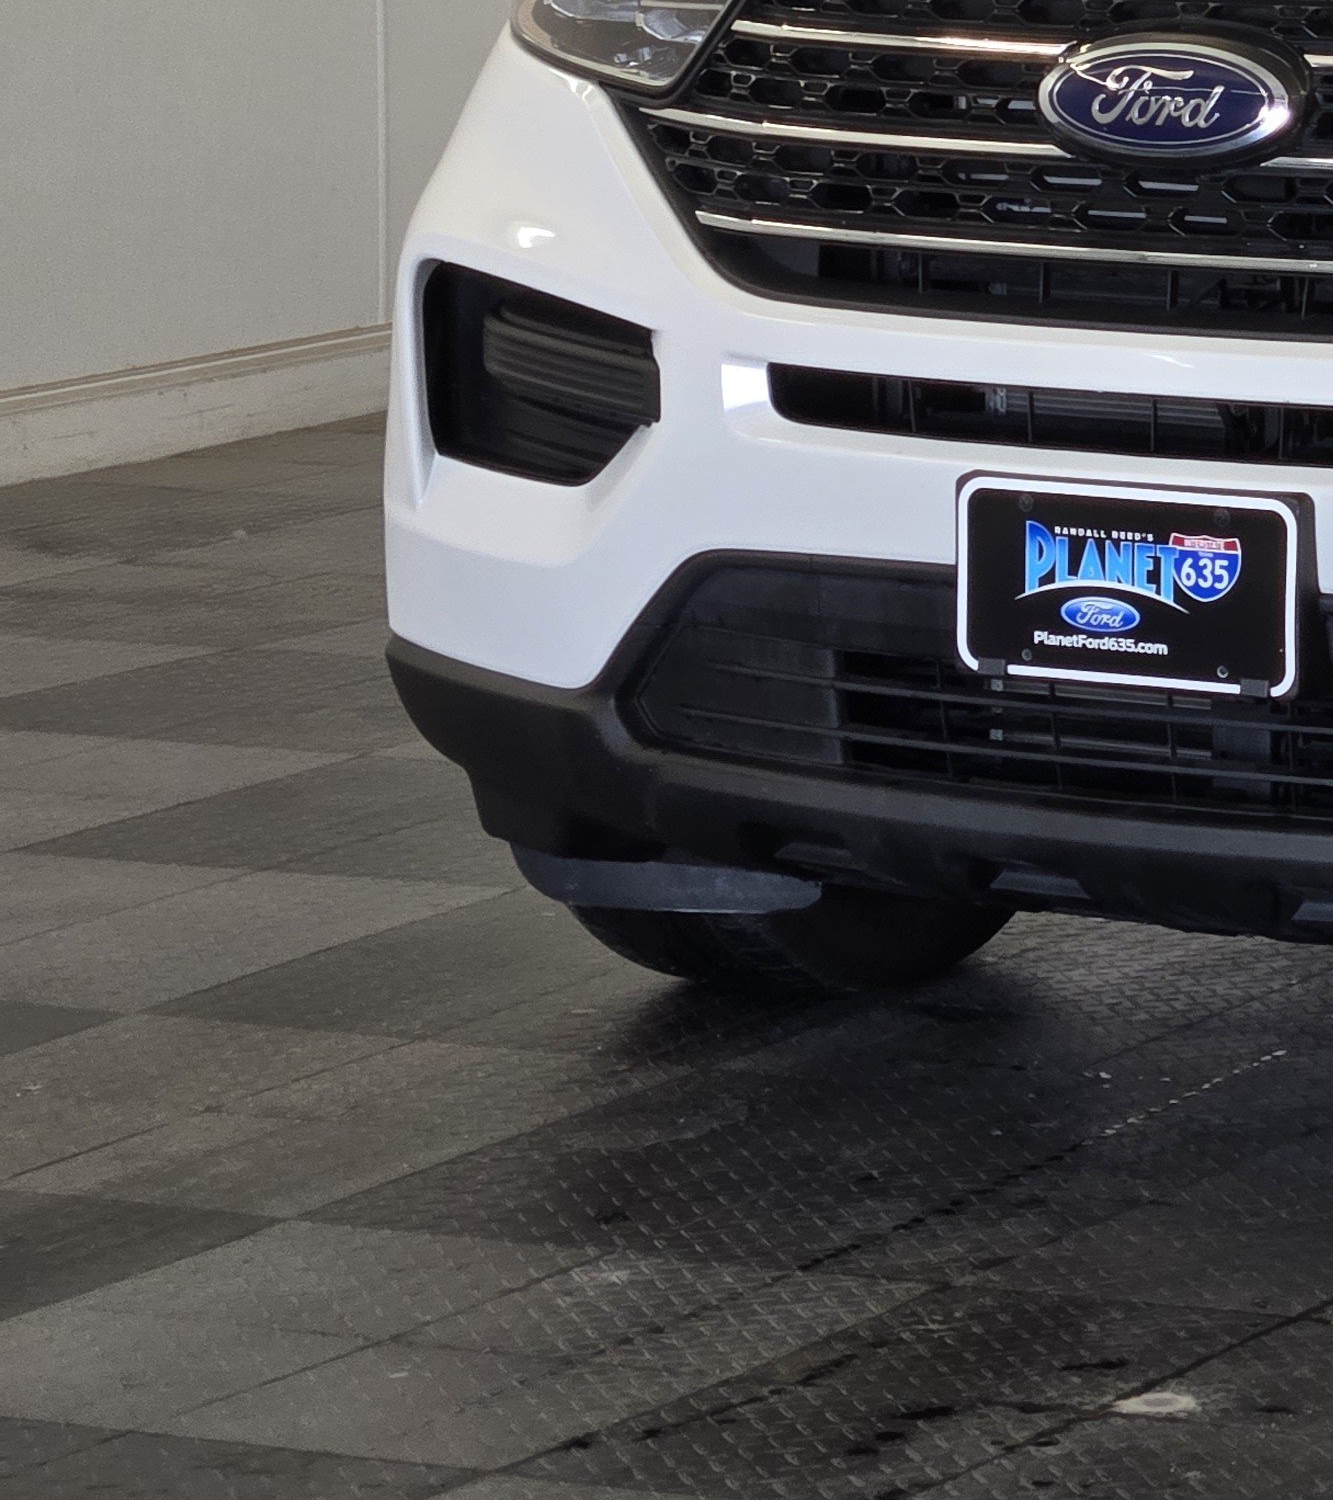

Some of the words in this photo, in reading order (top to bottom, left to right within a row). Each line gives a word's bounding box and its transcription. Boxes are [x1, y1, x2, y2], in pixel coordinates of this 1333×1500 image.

[1091, 64, 1221, 129] Ford
[1054, 526, 1107, 538] RANDALL
[1111, 530, 1154, 541] REED'S
[1025, 520, 1180, 603] PLANET
[1180, 557, 1230, 590] 635
[1075, 601, 1124, 628] Ford
[1033, 630, 1169, 655] PlanetFord635.com
